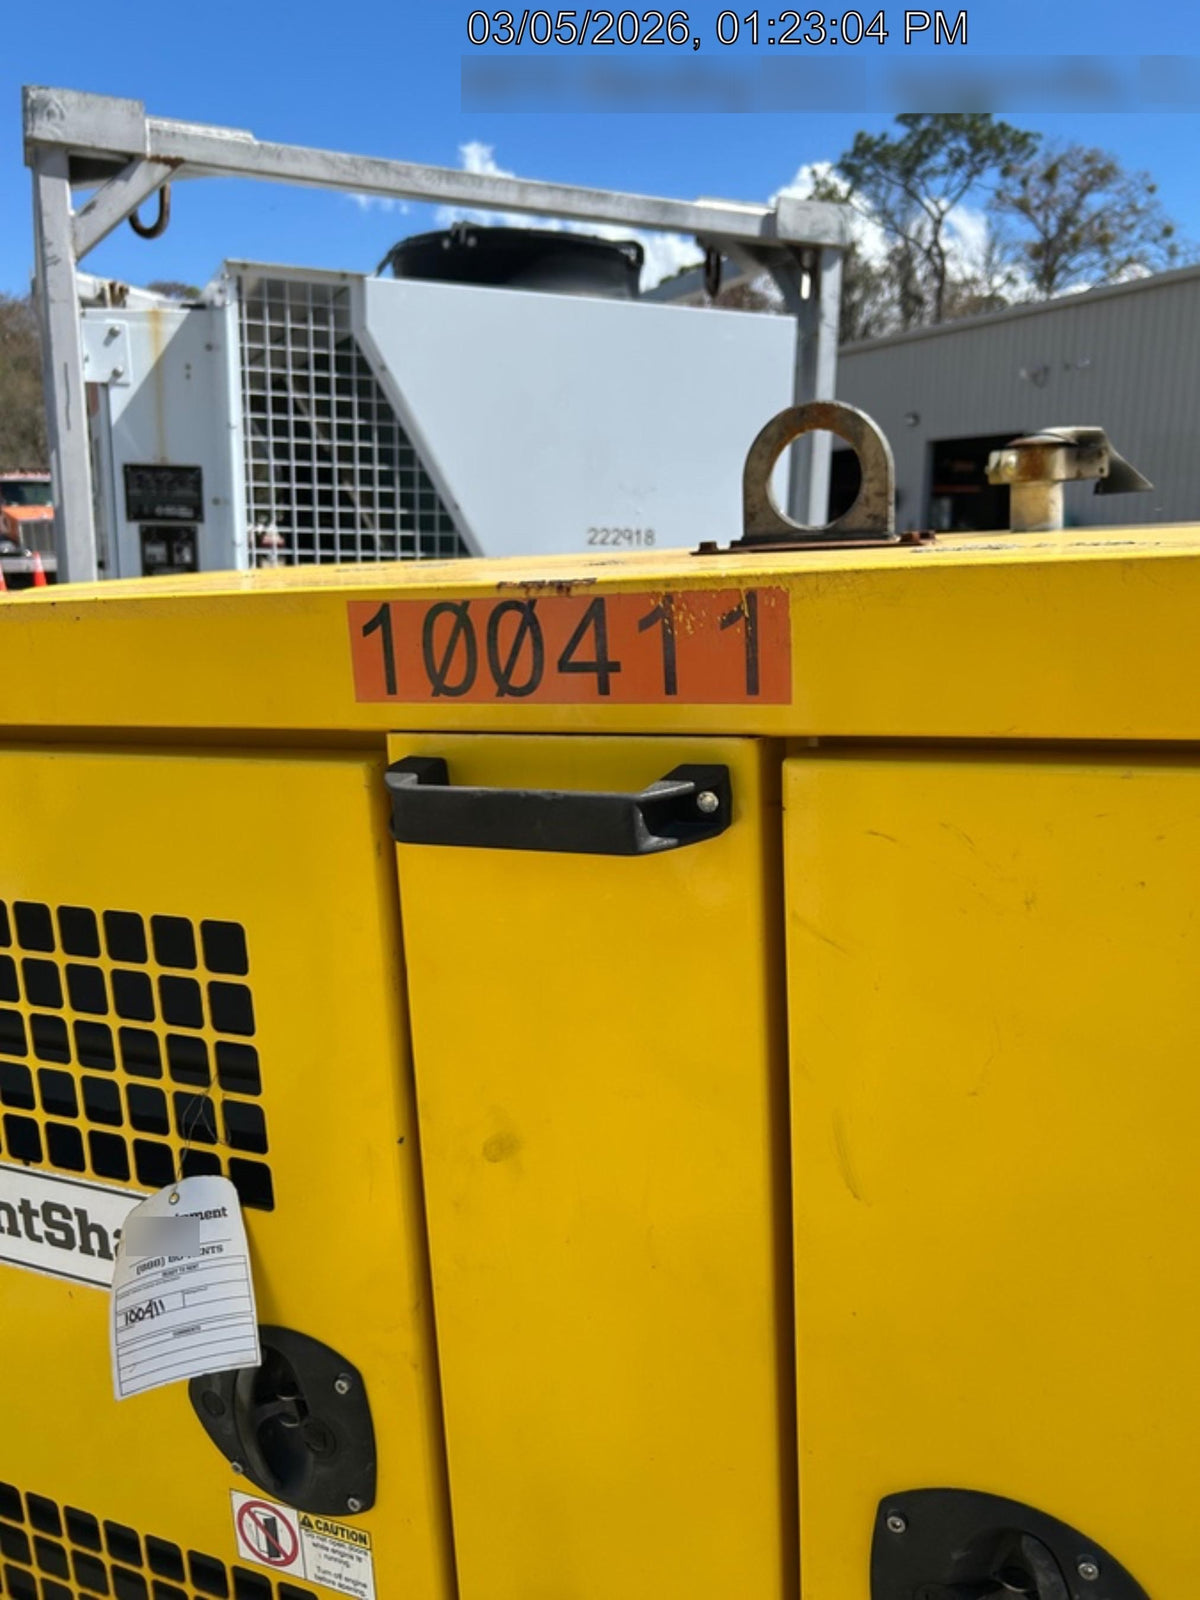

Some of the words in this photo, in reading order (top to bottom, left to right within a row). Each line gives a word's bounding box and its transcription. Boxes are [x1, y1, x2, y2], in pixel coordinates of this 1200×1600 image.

[587, 526, 656, 546] 222918
[361, 589, 761, 698] 100411
[125, 1299, 166, 1326] 100411
[314, 1519, 368, 1545] CAUTION
[330, 1547, 354, 1561] engine
[314, 1573, 337, 1586] before
[316, 1565, 332, 1576] Turn
[344, 1576, 368, 1588] engine
